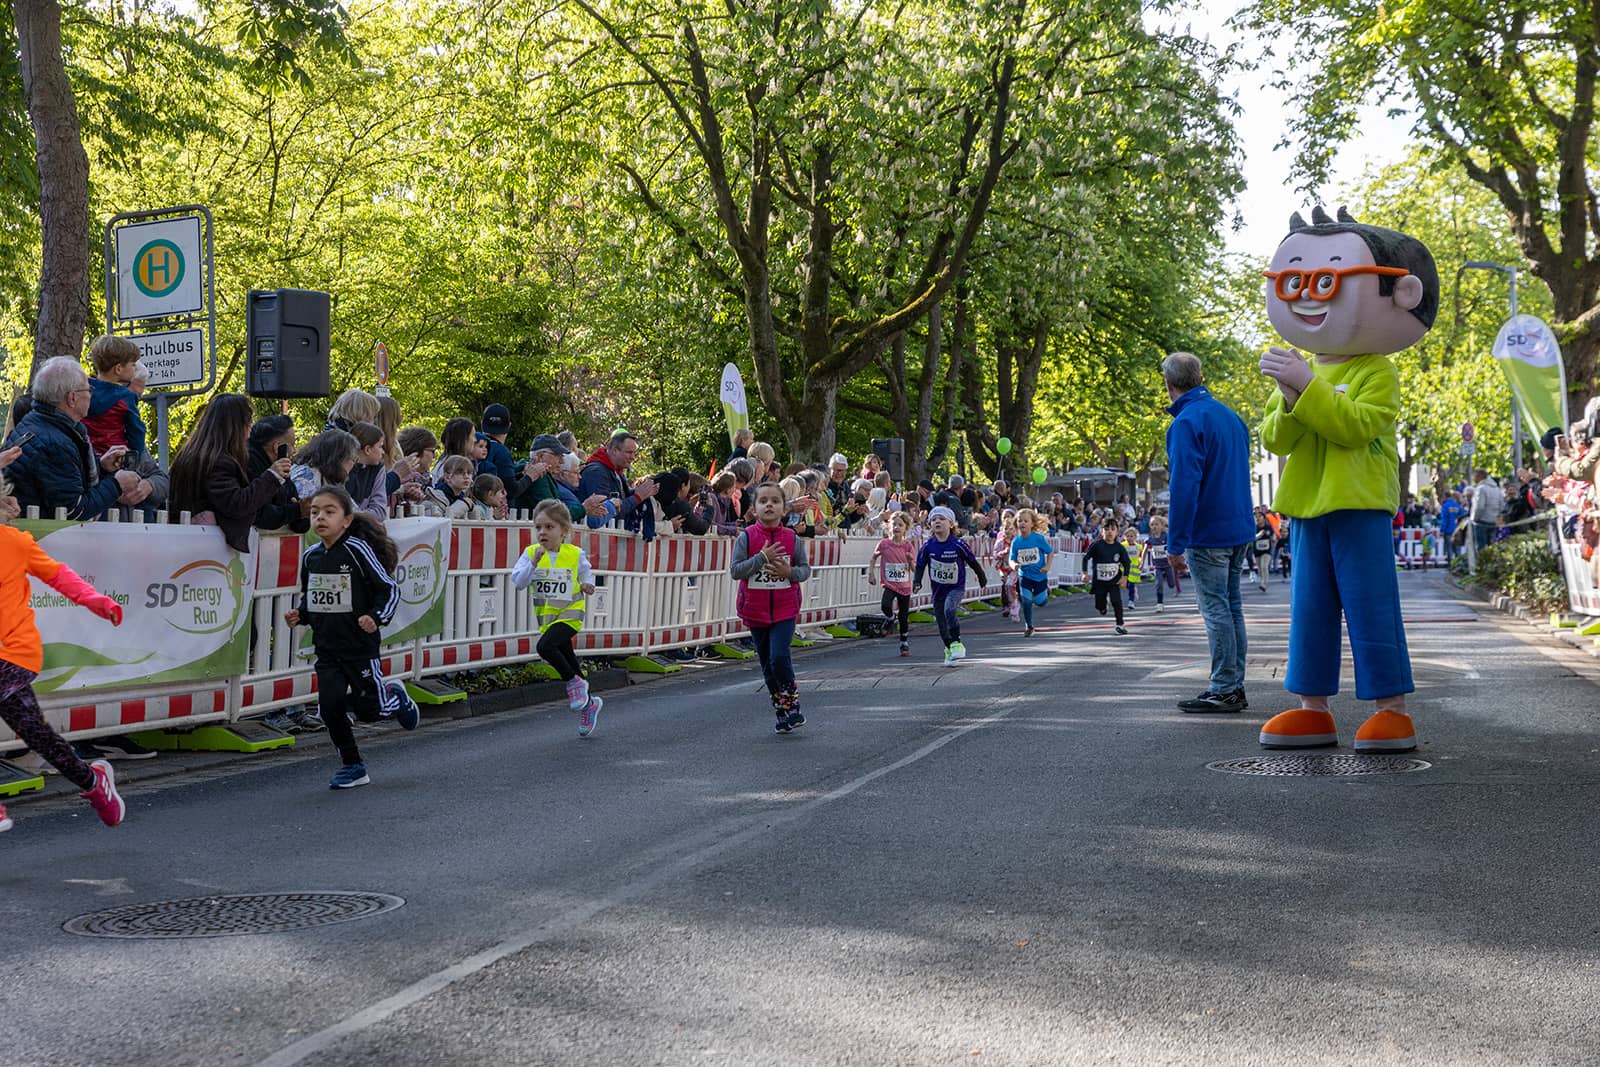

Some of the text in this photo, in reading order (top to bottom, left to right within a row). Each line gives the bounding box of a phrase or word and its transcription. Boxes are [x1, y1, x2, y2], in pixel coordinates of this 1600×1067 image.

[147, 251, 170, 287] H
[1507, 334, 1528, 347] SD
[139, 341, 194, 358] chulbus
[724, 380, 735, 392] SD
[933, 569, 954, 580] 1634
[536, 581, 567, 594] 2670
[144, 582, 179, 609] SD
[181, 583, 222, 606] Energy
[311, 590, 342, 605] 3261
[193, 606, 218, 625] Run
